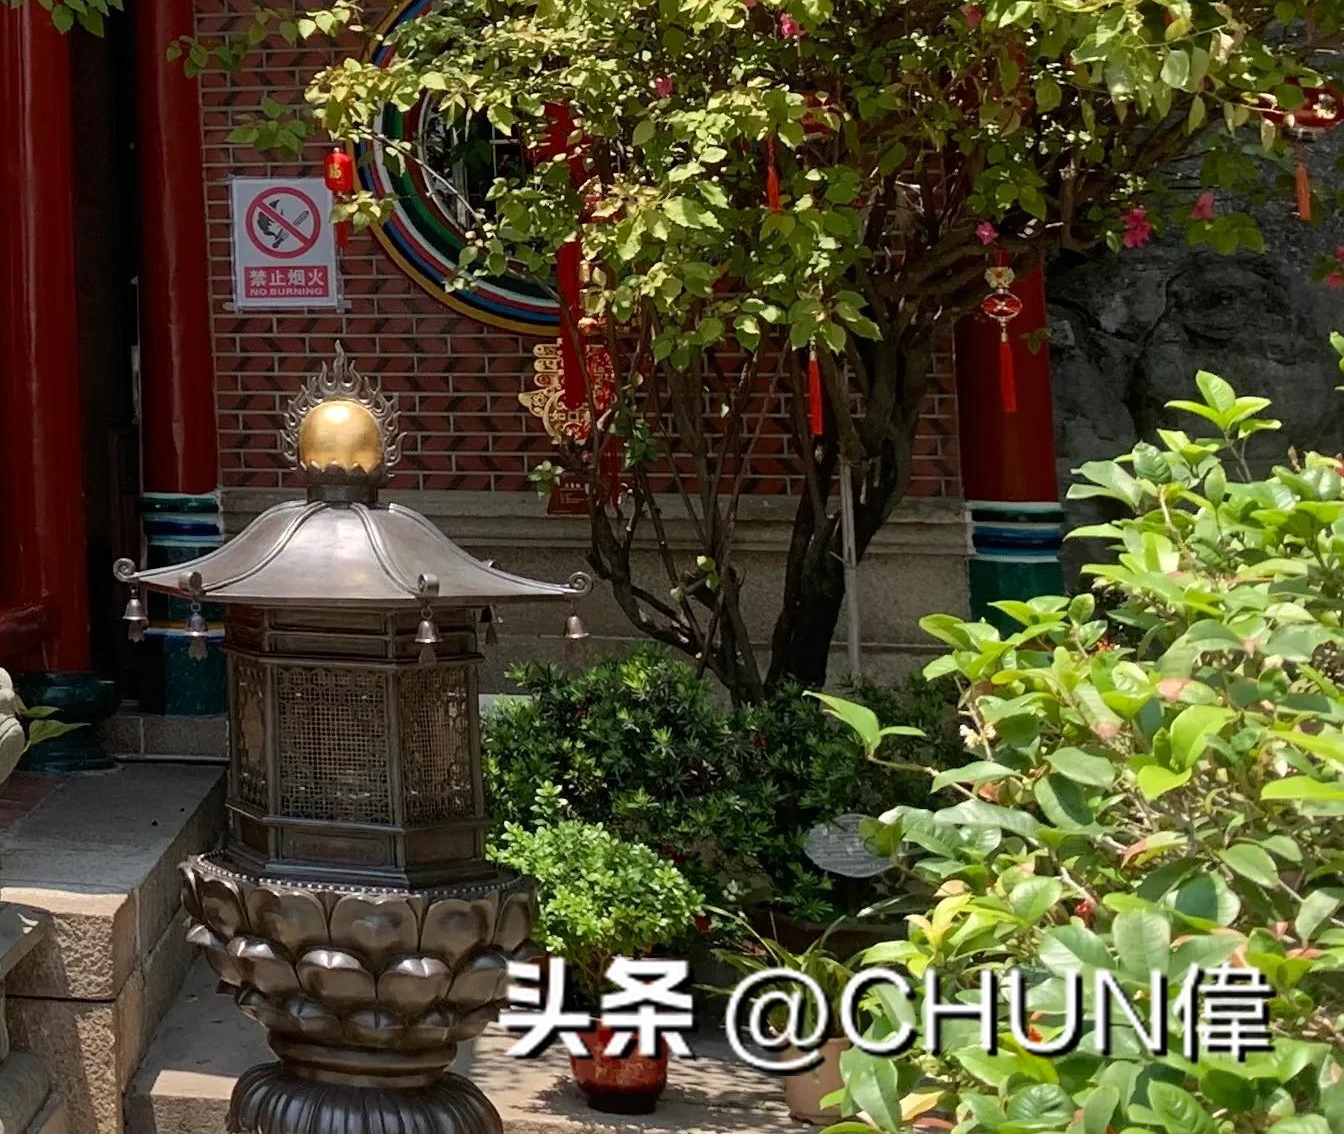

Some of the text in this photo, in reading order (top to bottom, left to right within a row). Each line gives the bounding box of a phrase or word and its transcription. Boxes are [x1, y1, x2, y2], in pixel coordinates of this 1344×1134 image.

[250, 269, 325, 287] 禁止烟火
[250, 287, 323, 296] NO BURNING
